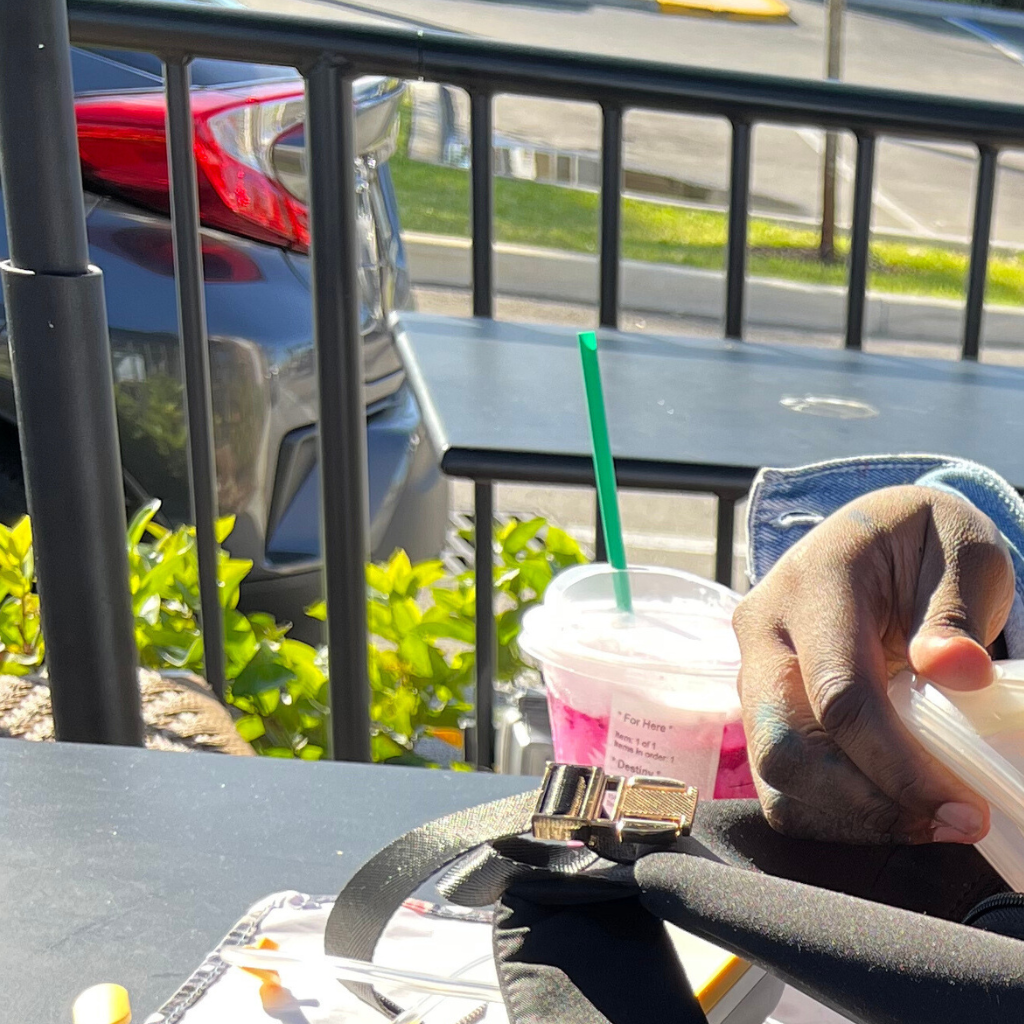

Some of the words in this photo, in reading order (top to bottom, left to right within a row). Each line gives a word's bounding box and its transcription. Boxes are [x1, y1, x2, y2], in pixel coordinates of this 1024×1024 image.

[624, 713, 641, 726] For
[642, 718, 666, 733] Here
[614, 740, 634, 753] Items
[635, 748, 643, 756] in
[641, 740, 651, 748] of
[617, 759, 654, 776] Destiny
